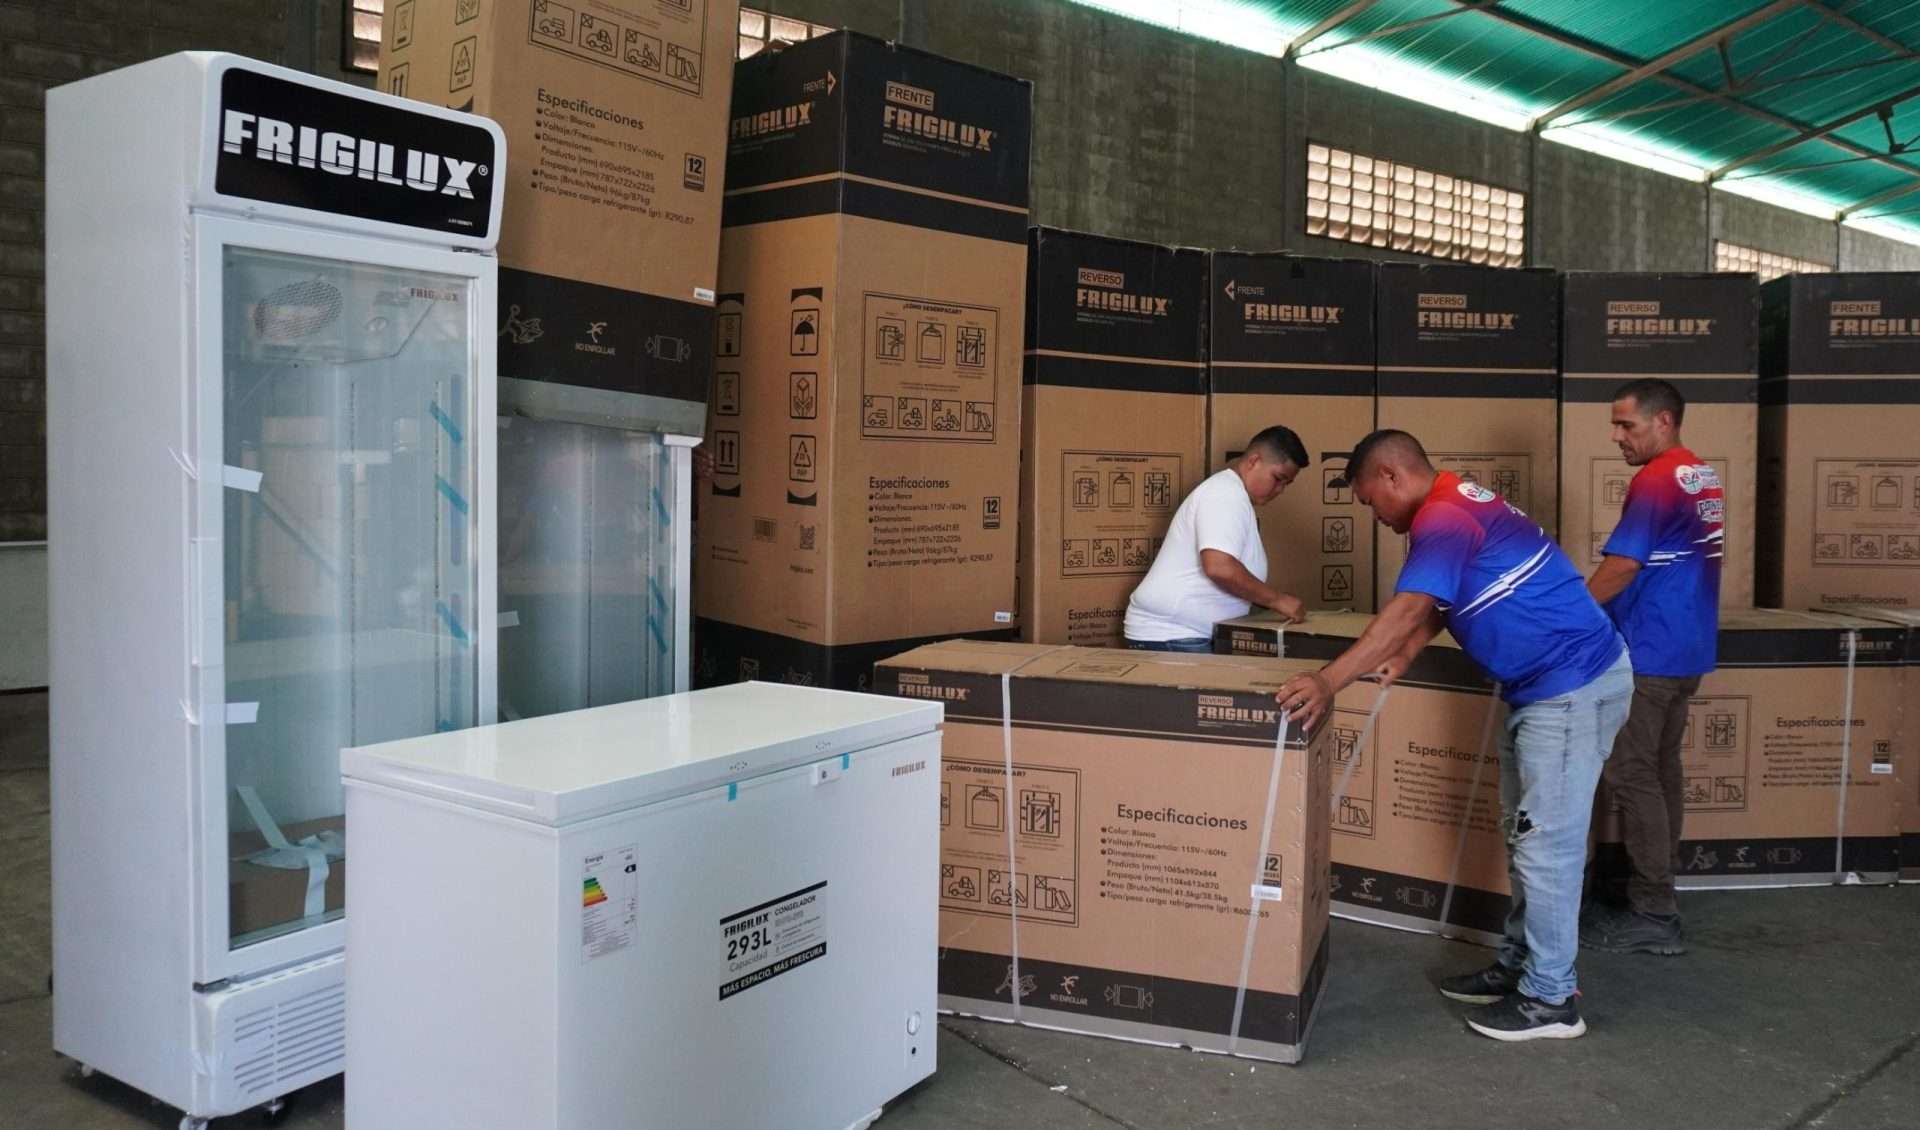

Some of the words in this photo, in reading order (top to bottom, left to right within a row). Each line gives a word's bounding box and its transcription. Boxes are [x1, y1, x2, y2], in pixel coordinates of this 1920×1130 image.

[803, 79, 825, 93] FRENTE
[888, 86, 932, 106] FRENTE
[537, 88, 644, 130] Especificaciones
[883, 105, 993, 152] FRIGILUX
[689, 158, 702, 175] 12
[1080, 271, 1122, 285] REVERSO
[1237, 286, 1265, 296] FRENTE
[1077, 288, 1168, 317] FRIGILUX
[1420, 296, 1465, 306] REVERSO
[1610, 303, 1658, 313] REVERSO
[1833, 304, 1880, 313] FRENTE
[1245, 303, 1340, 323] FRIGILUX
[1418, 312, 1514, 330] FRIGILUX
[1608, 318, 1712, 336] FRIGILUX
[869, 476, 950, 491] Especificaciones
[986, 499, 998, 514] 12
[898, 684, 967, 701] FRIGILUX
[1198, 705, 1276, 723] FRIGILUX
[973, 767, 1026, 776] DESEMPAAR?
[1117, 803, 1248, 831] Especificaciones
[774, 895, 816, 916] CONGELADOR
[724, 912, 769, 938] FRIGILUX
[727, 927, 772, 961] 293L
[729, 949, 768, 973] Capacidad
[790, 946, 823, 967] FRESCURA
